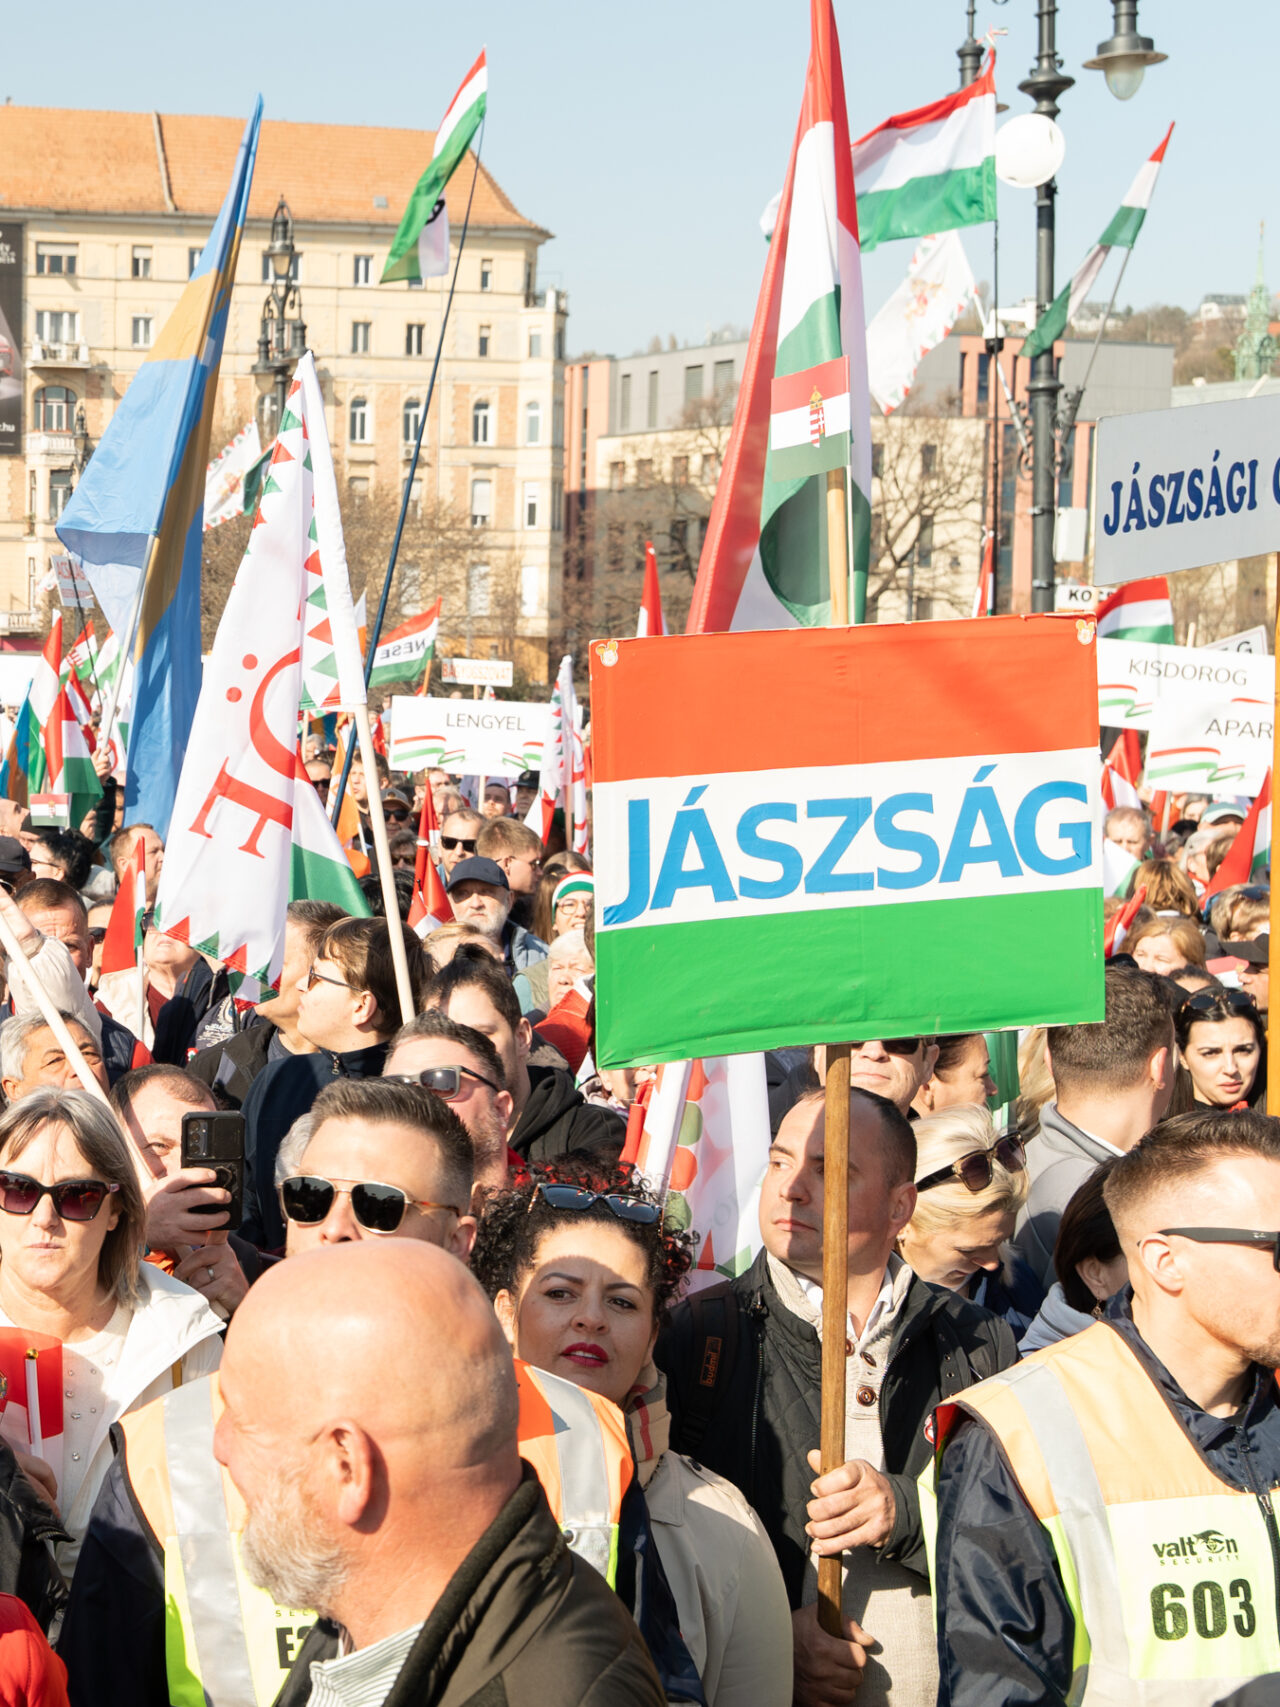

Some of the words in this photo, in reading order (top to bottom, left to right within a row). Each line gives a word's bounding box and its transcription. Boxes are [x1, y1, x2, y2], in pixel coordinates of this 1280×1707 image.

[1103, 449, 1259, 536] JÁSZSÁGI
[1128, 657, 1248, 687] KISDOROG
[445, 712, 526, 732] LENGYEL
[1204, 717, 1274, 740] APAR
[603, 764, 1093, 926] JÁSZSÁG
[1160, 1555, 1240, 1567] SECURITY
[1150, 1578, 1257, 1641] 603
